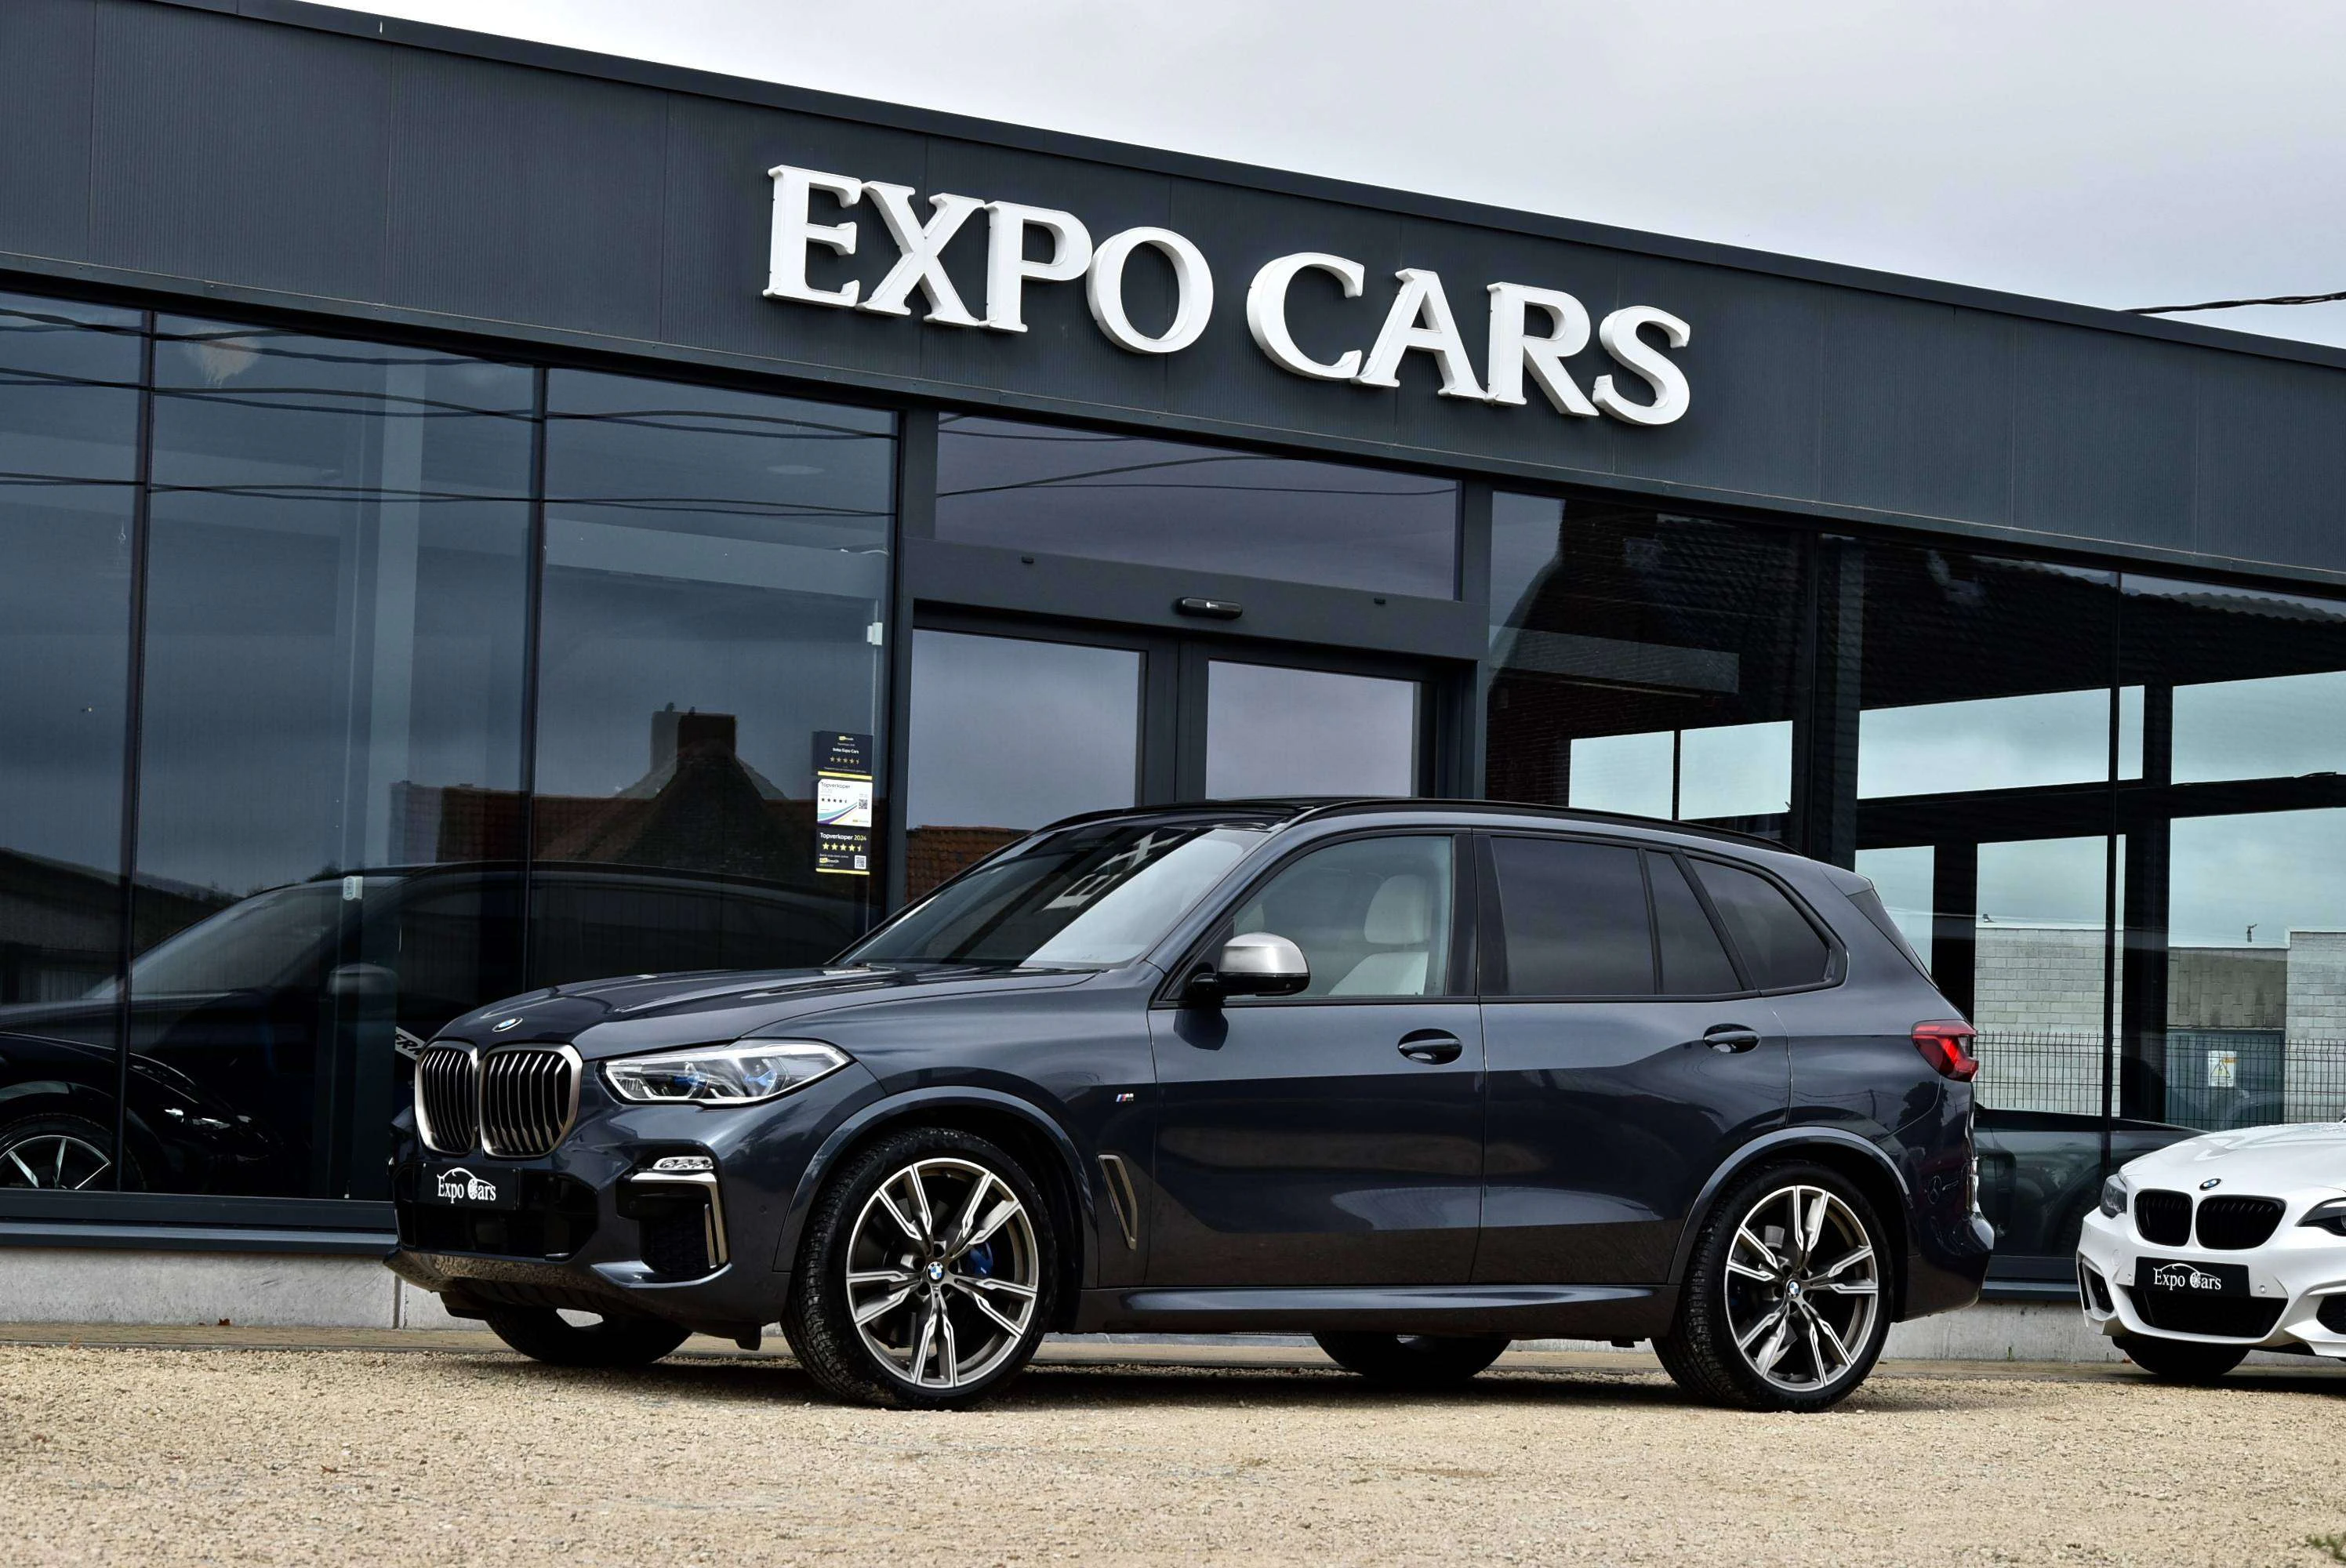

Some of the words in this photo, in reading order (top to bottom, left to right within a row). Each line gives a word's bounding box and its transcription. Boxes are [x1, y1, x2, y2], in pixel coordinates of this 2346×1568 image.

[763, 164, 1214, 354] EXPO
[1247, 251, 1690, 426] CARS
[819, 832, 854, 840] Topverkoper
[437, 1174, 464, 1204] Expo
[467, 1178, 497, 1201] Cars
[2153, 1268, 2186, 1291] Expo
[2189, 1271, 2222, 1290] Cars
